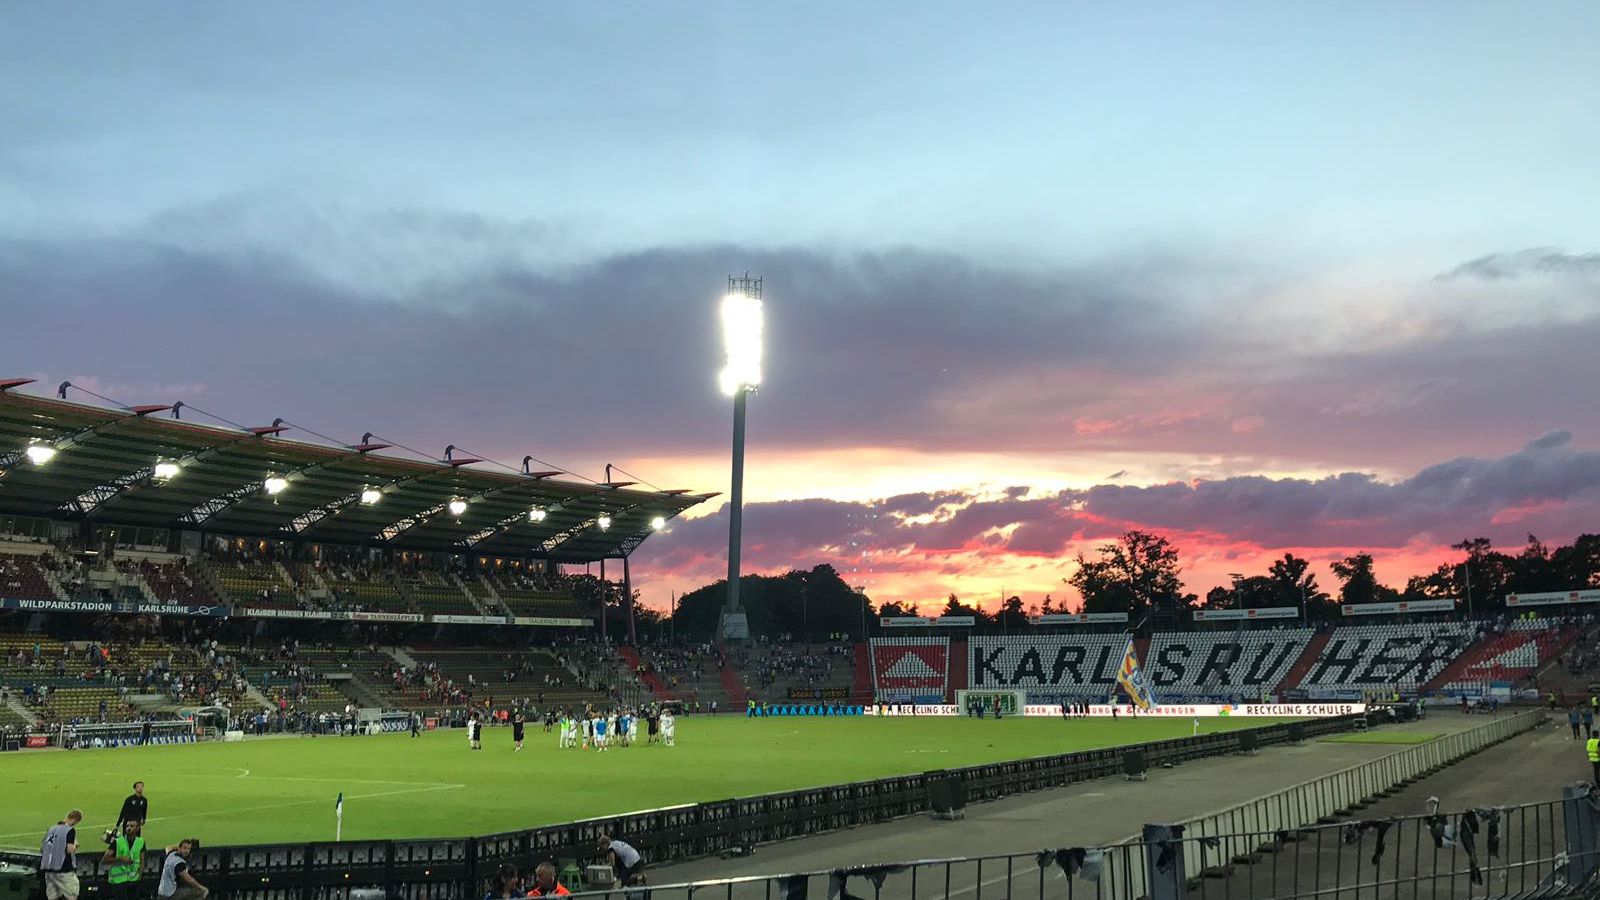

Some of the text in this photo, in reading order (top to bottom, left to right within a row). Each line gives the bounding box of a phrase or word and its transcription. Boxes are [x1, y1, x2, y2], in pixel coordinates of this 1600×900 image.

[19, 599, 189, 614] WILDPARKSTADION KARLSRUHE
[1246, 705, 1305, 715] RECYCLING
